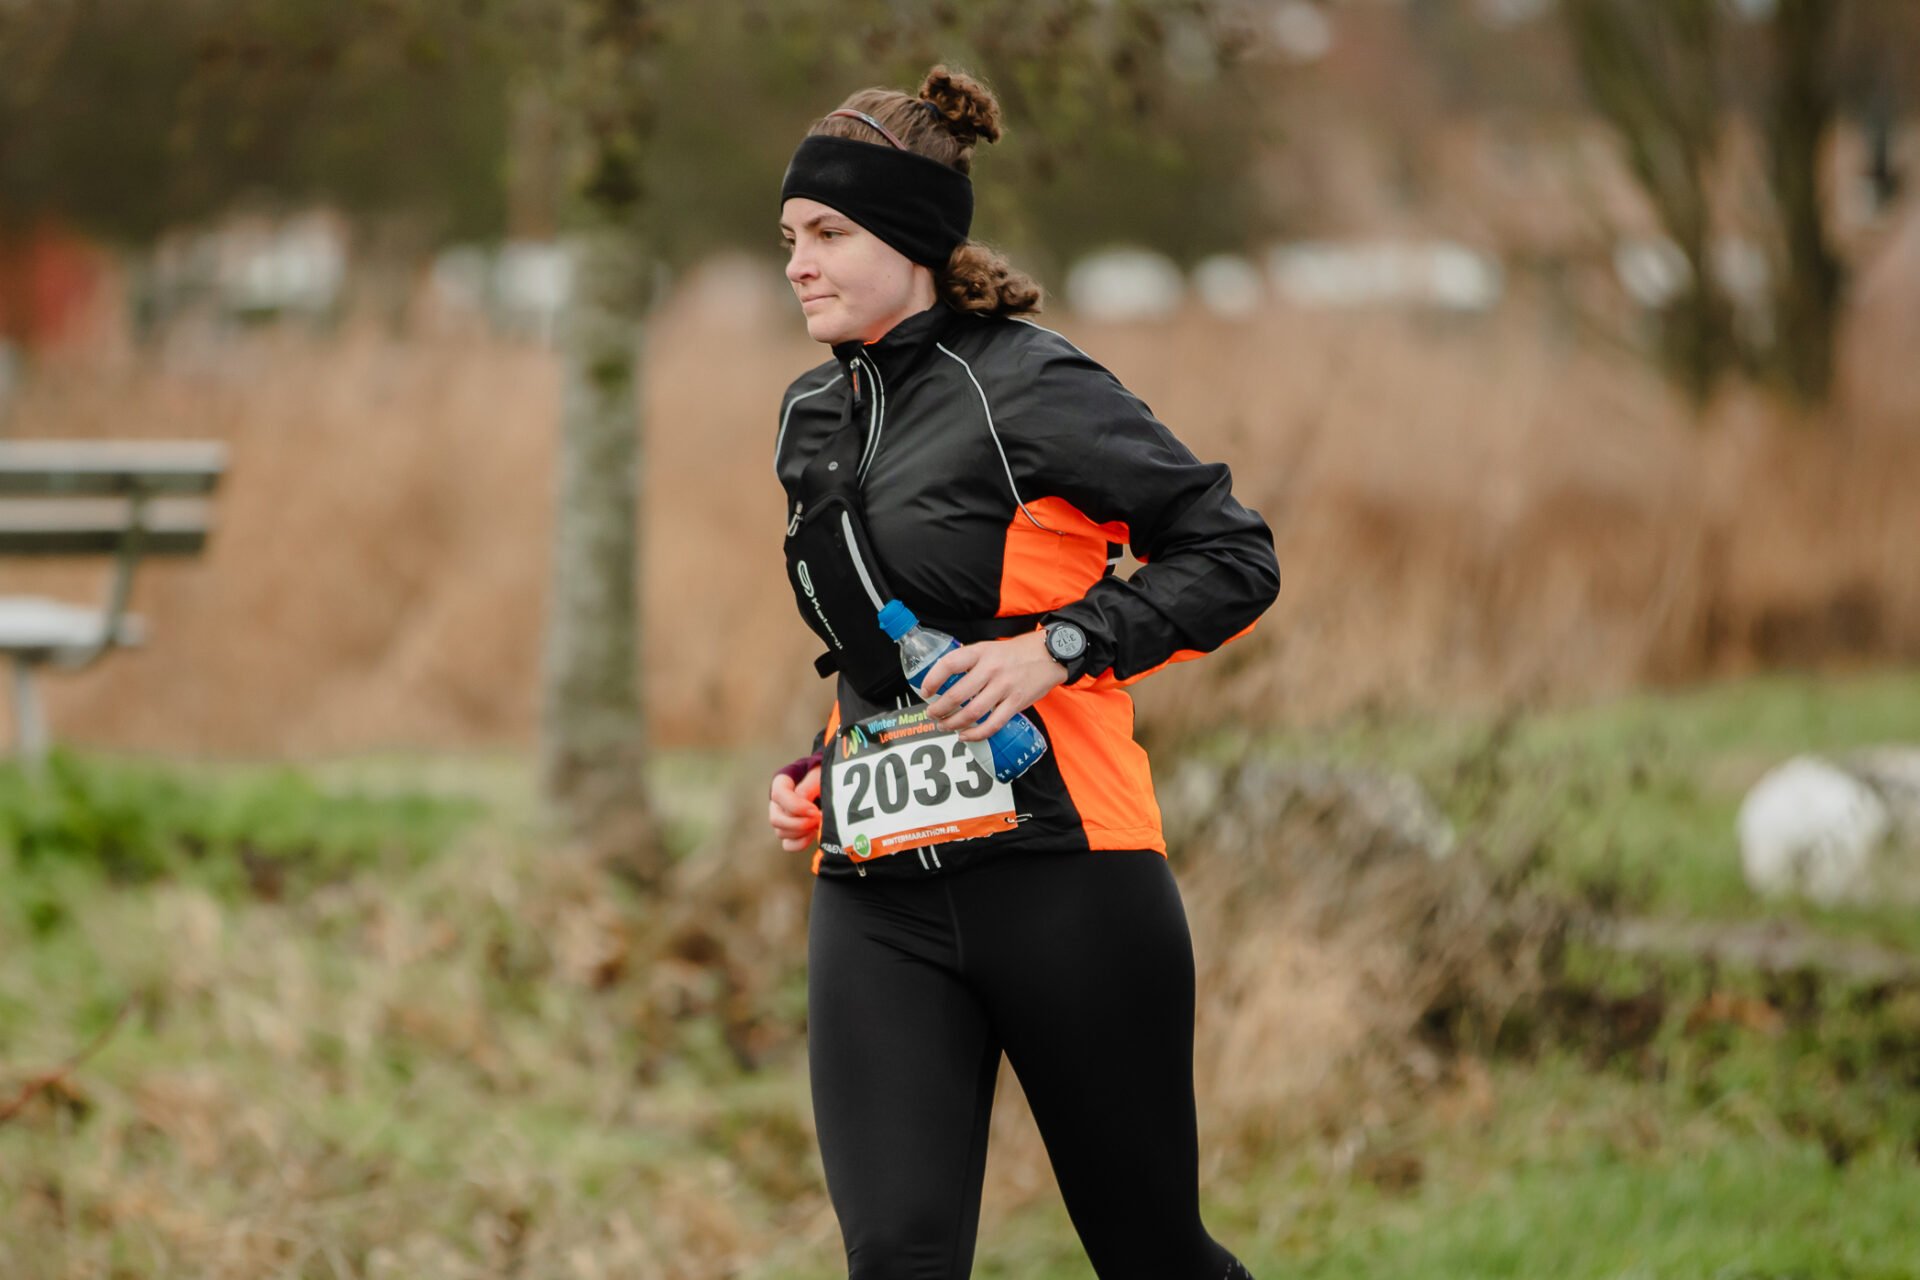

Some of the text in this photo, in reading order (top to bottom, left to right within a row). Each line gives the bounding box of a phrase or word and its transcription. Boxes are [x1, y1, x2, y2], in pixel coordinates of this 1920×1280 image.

[867, 709, 928, 734] Winter Marat
[879, 722, 936, 744] Leeuwarden
[843, 741, 993, 825] 2033
[881, 825, 960, 847] WINTERMARATHON.FRL
